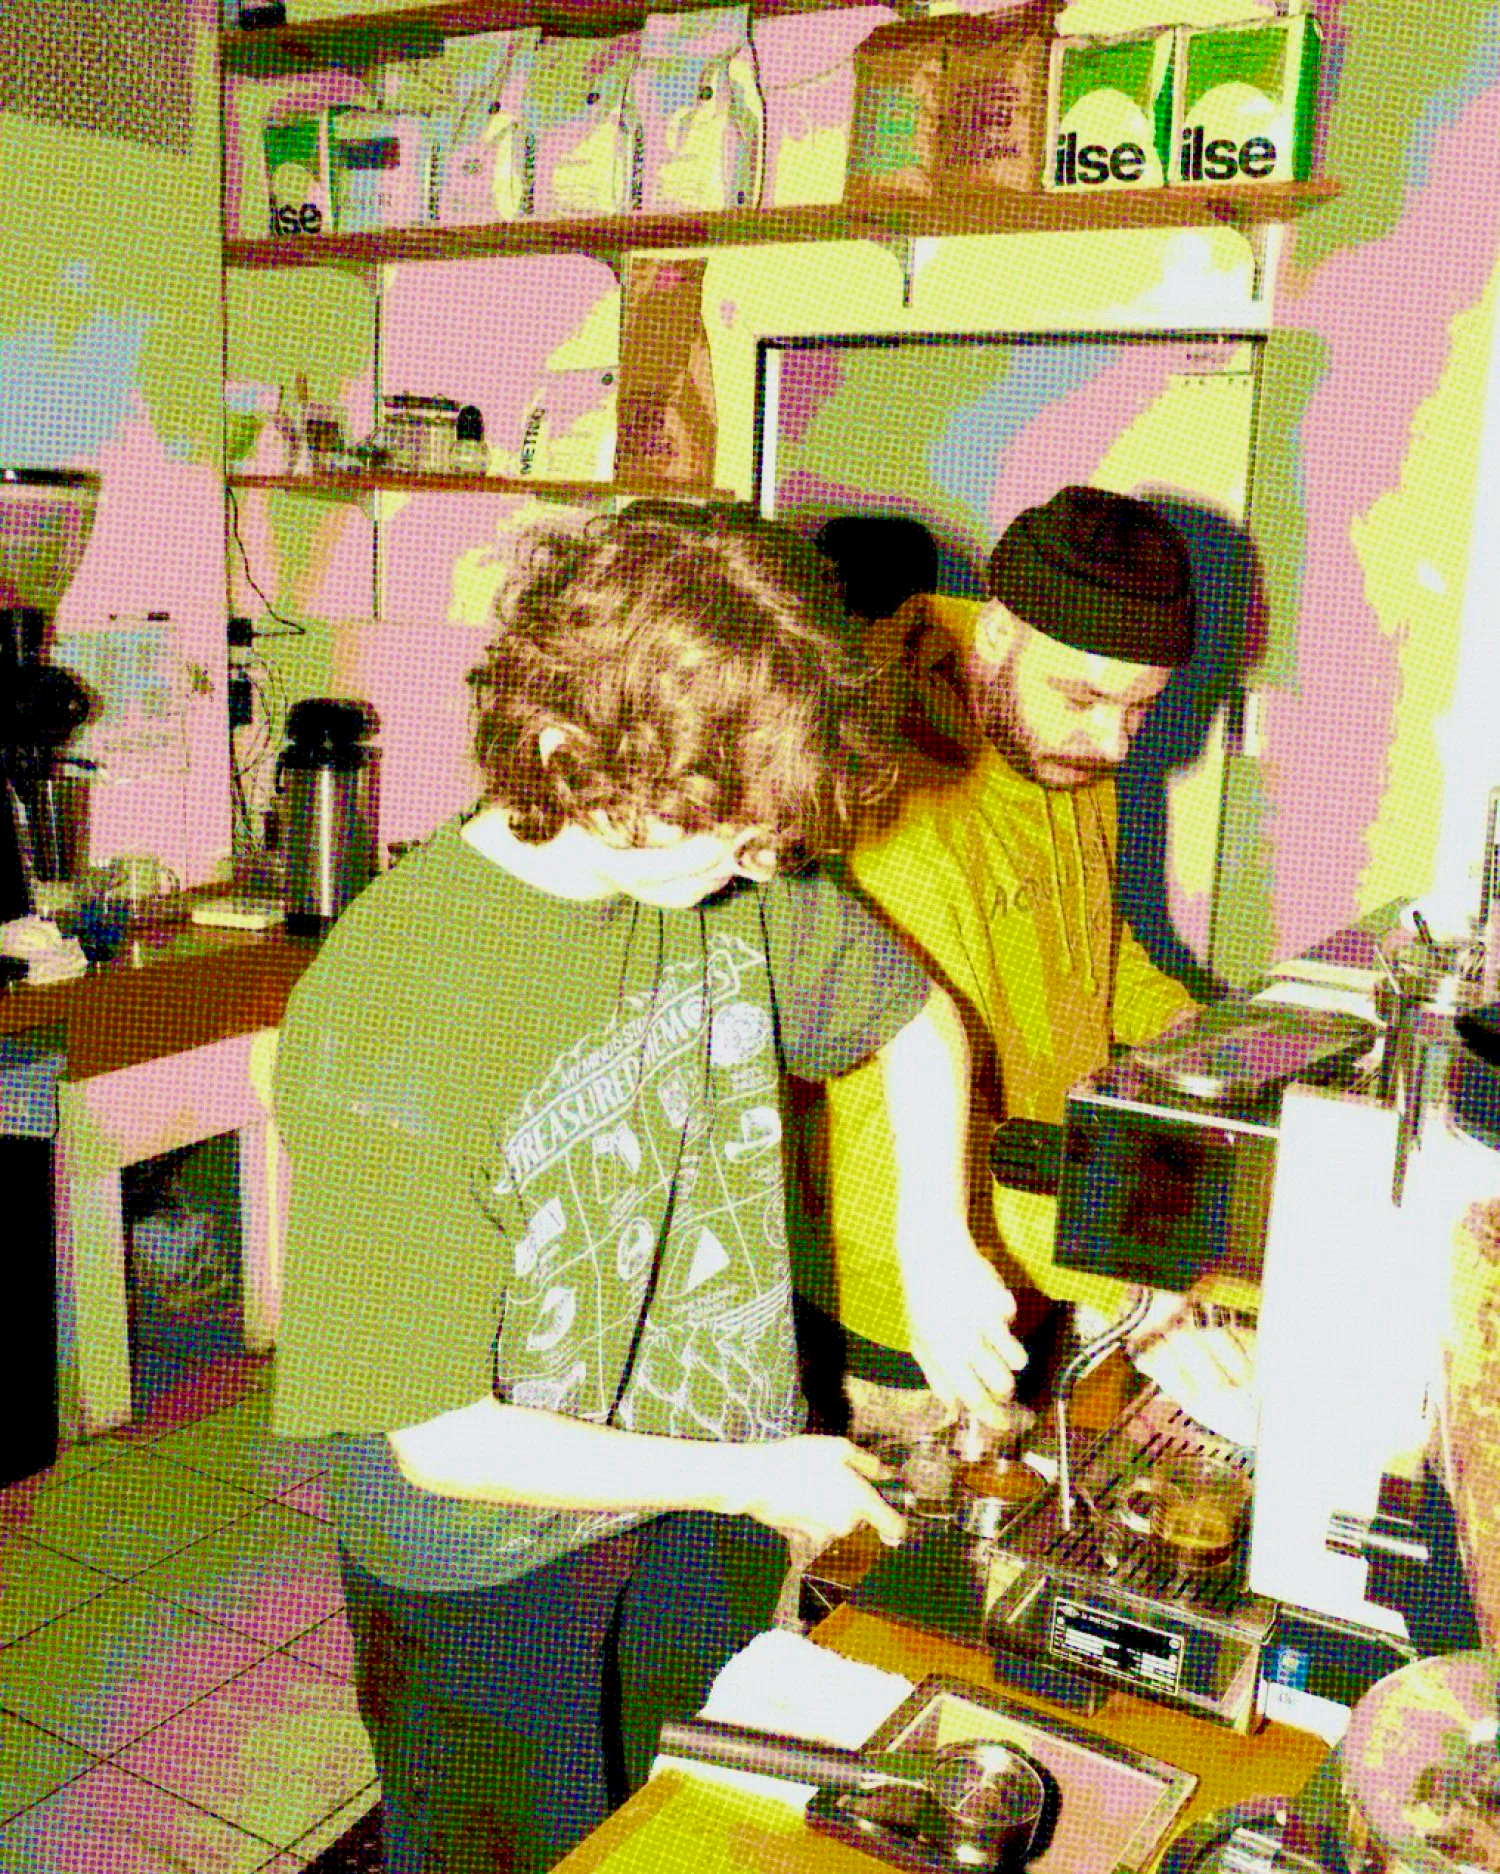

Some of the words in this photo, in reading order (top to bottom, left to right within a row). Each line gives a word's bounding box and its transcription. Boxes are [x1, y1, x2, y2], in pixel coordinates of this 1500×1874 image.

[1055, 131, 1146, 186] ilse
[1180, 125, 1277, 181] ilse
[506, 1054, 643, 1184] TREASURED
